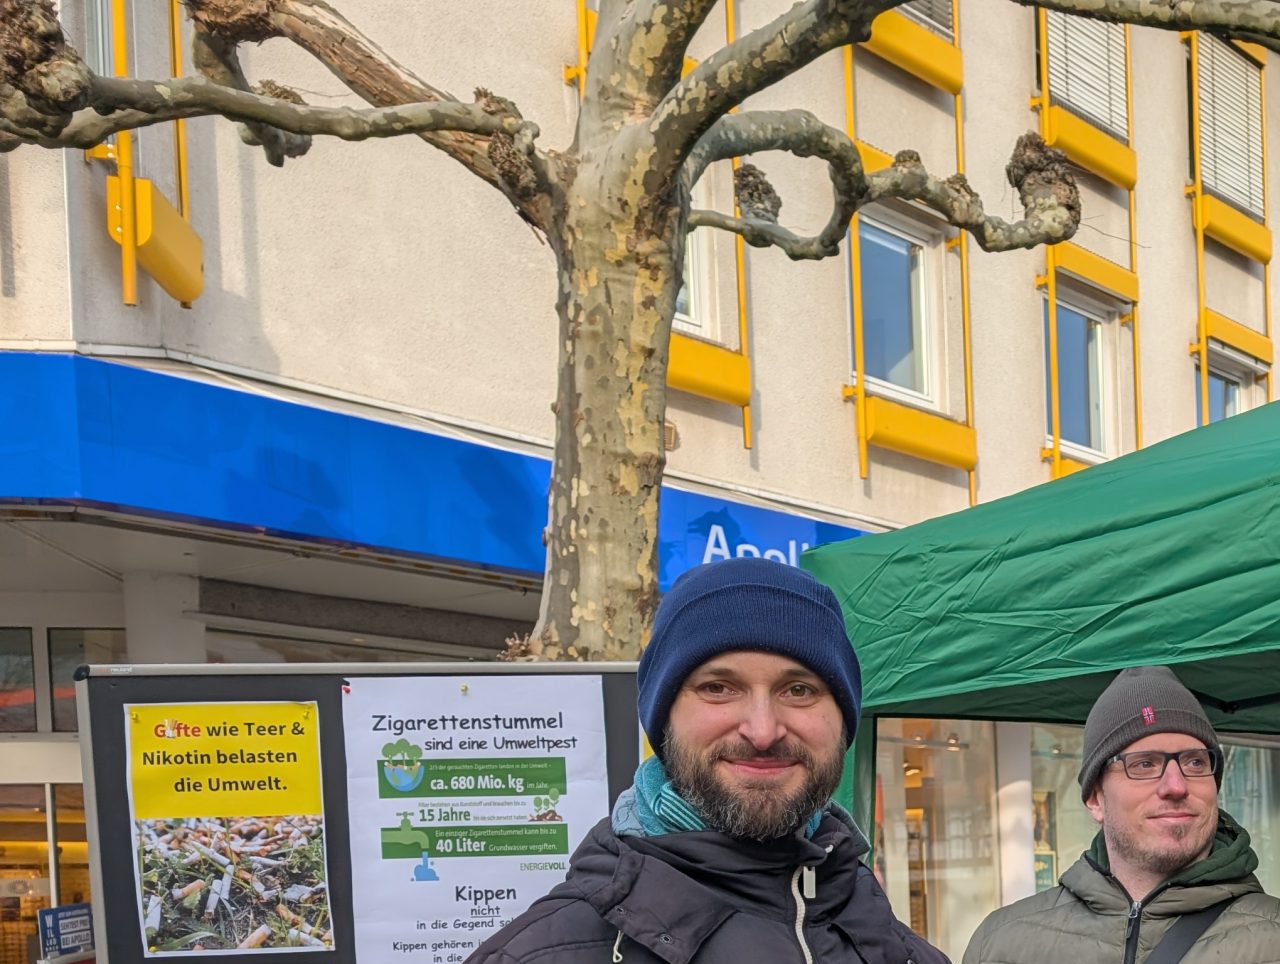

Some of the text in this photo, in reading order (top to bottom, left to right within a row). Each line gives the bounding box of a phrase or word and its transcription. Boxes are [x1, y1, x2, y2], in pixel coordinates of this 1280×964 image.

[154, 722, 305, 738] Gfte wie Teer &
[371, 711, 564, 736] Zigarettenstummel
[424, 736, 578, 753] sind eine Umweltpest
[142, 749, 298, 766] Nikotin belasten
[174, 776, 288, 793] die Umwelt.
[430, 777, 449, 791] ca.
[450, 775, 475, 790] 680
[477, 774, 506, 790] Mio.
[508, 774, 525, 793] kg
[535, 781, 549, 789] Jahr.
[419, 808, 435, 822] 15
[437, 806, 471, 822] Jahre
[445, 829, 469, 839] einziger
[468, 828, 524, 838] Zigarettenstummel
[524, 827, 539, 835] kann
[540, 827, 549, 835] bis
[435, 837, 558, 853] 40 Liter Grundwasser vergiften.
[520, 861, 566, 872] ENERGIEVOLL
[455, 885, 517, 906] Kippen
[470, 904, 502, 917] nicht
[416, 920, 427, 930] in
[431, 919, 448, 930] die
[453, 918, 495, 931] Gegend
[61, 932, 90, 946] BEI APOLLO
[392, 941, 428, 953] Kippen
[431, 940, 474, 952] gehören
[433, 953, 463, 963] in die
